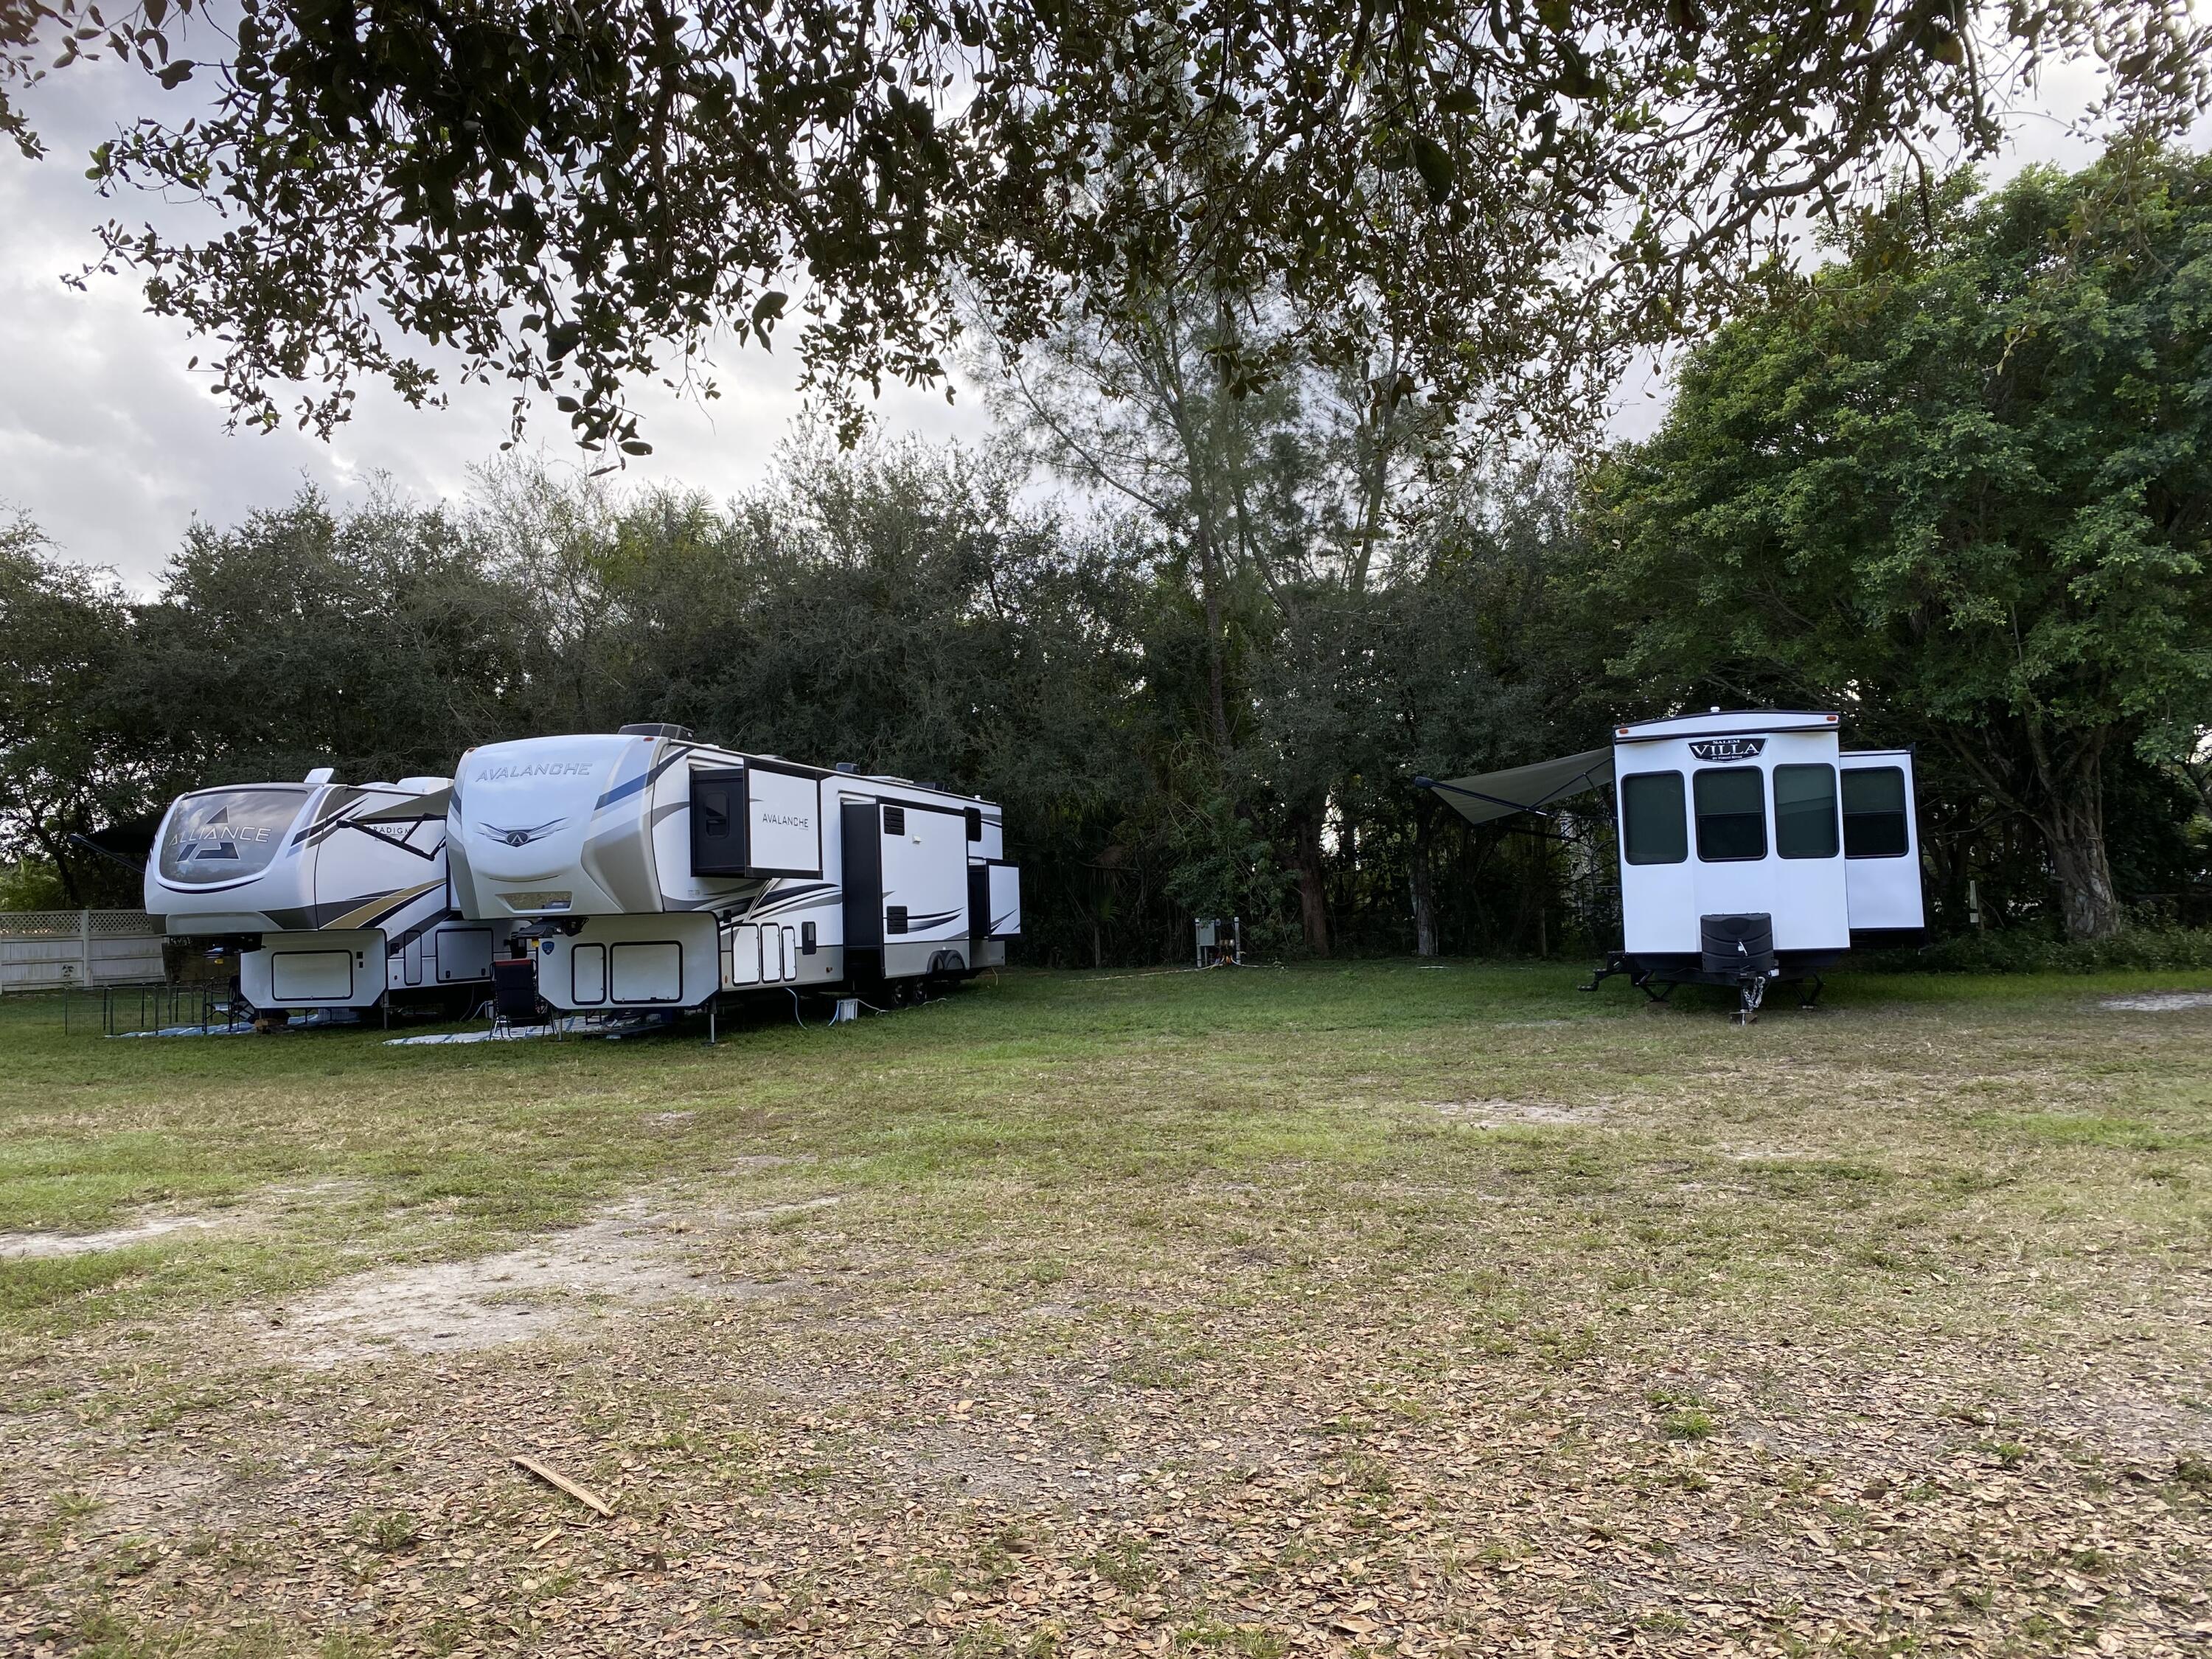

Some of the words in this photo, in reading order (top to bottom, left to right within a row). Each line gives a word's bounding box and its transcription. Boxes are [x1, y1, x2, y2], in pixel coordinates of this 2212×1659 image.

[1691, 743, 1759, 756] VILLA
[476, 763, 593, 782] AVALANCHE
[762, 813, 809, 828] AVALANCHE
[169, 826, 272, 847] ALLIANCE
